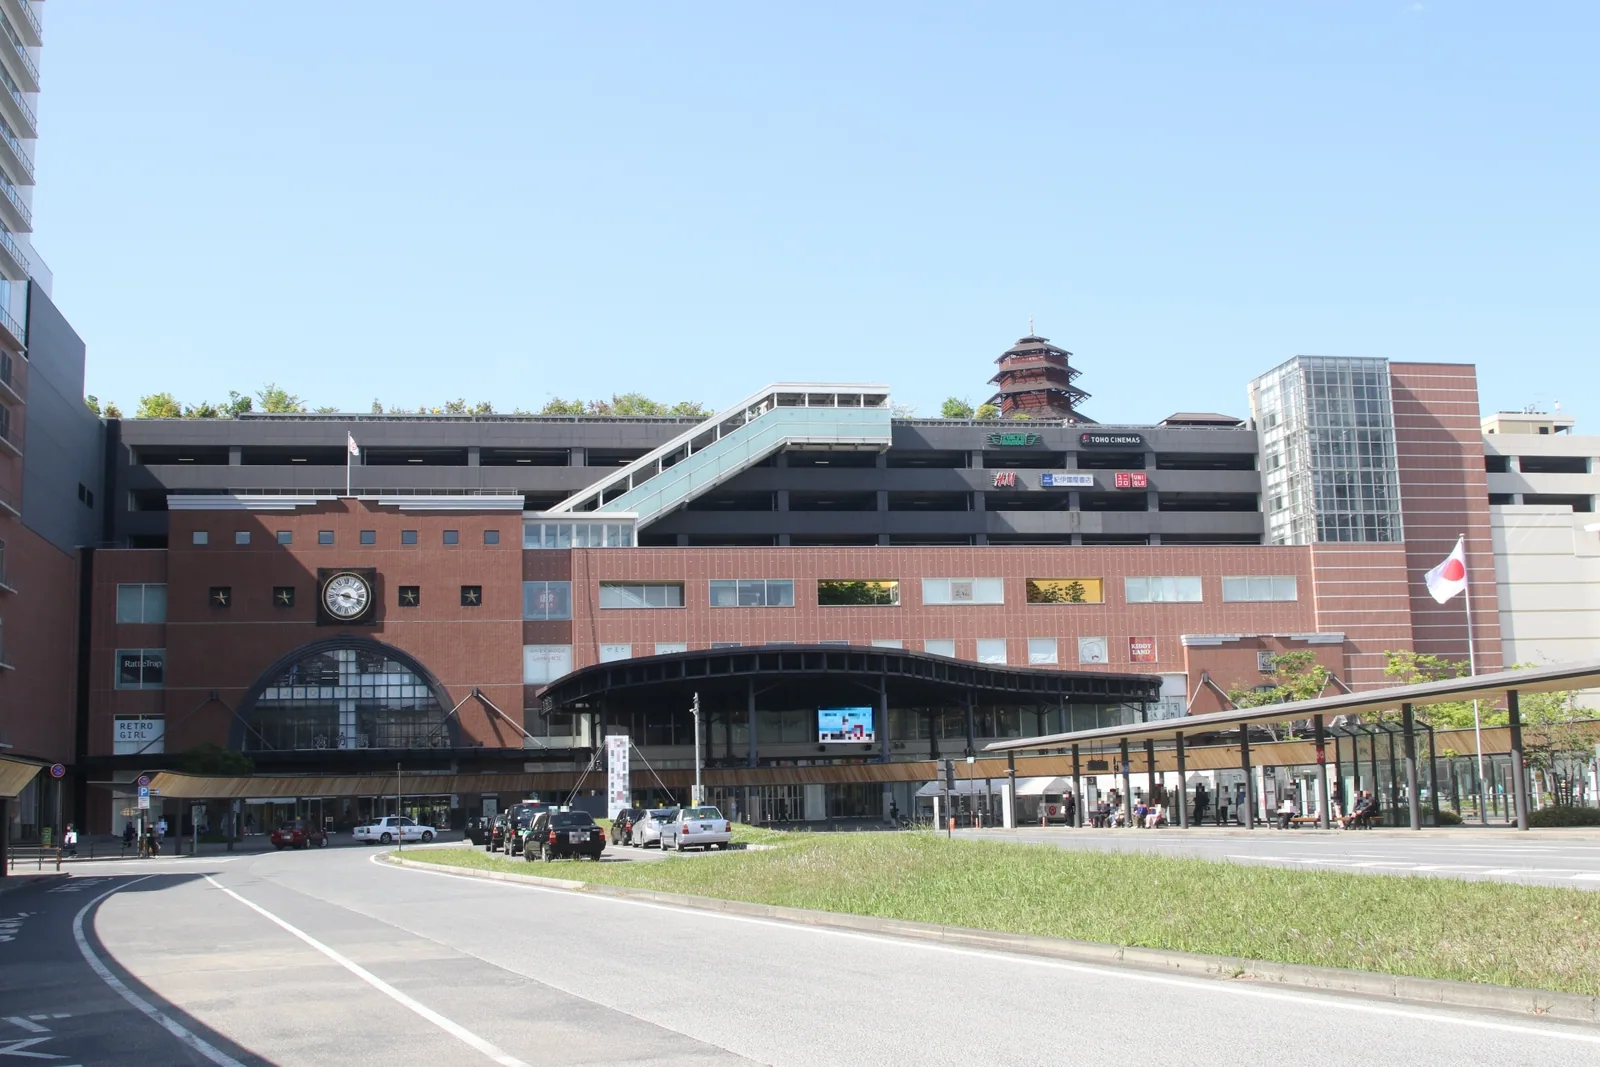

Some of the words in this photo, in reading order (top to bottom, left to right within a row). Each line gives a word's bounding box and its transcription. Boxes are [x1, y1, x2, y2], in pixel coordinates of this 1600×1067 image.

[124, 660, 162, 668] RatteTrap
[120, 722, 153, 730] RETRO
[120, 731, 147, 739] GIRL
[141, 787, 148, 796] P
